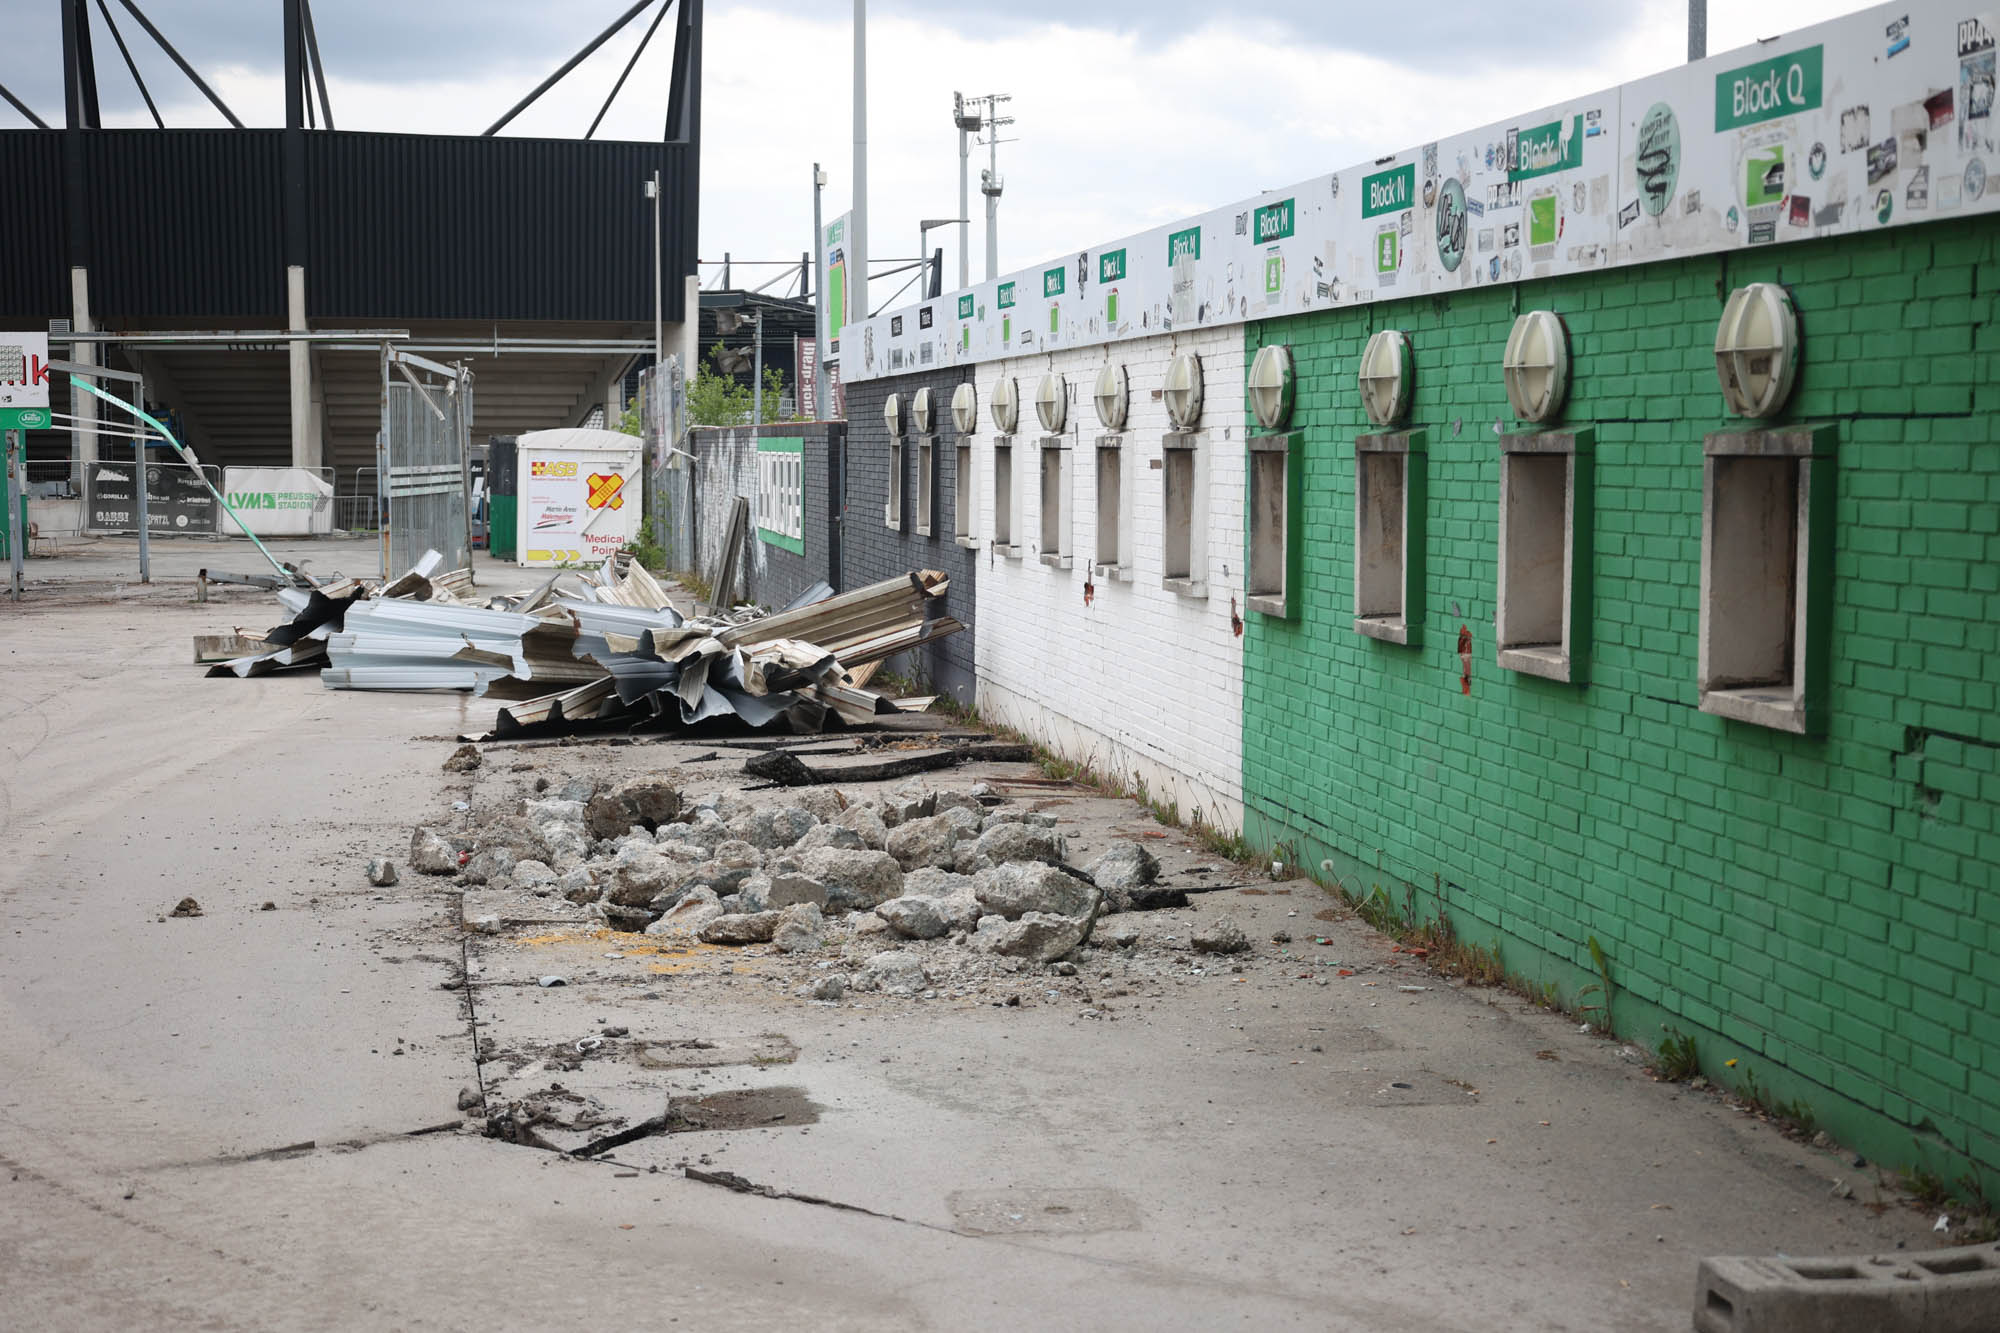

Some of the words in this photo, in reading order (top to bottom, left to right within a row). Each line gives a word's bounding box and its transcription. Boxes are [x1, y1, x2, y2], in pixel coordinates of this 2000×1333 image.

[1733, 69, 1782, 118] Block
[1786, 63, 1806, 105] Q
[1370, 177, 1396, 209] Block
[1397, 174, 1405, 203] N
[1260, 209, 1280, 237] Block
[1280, 207, 1289, 232] M
[801, 341, 816, 419] ruck-drauf
[543, 460, 578, 477] ASB
[228, 492, 261, 509] LVM
[585, 534, 625, 543] Medical
